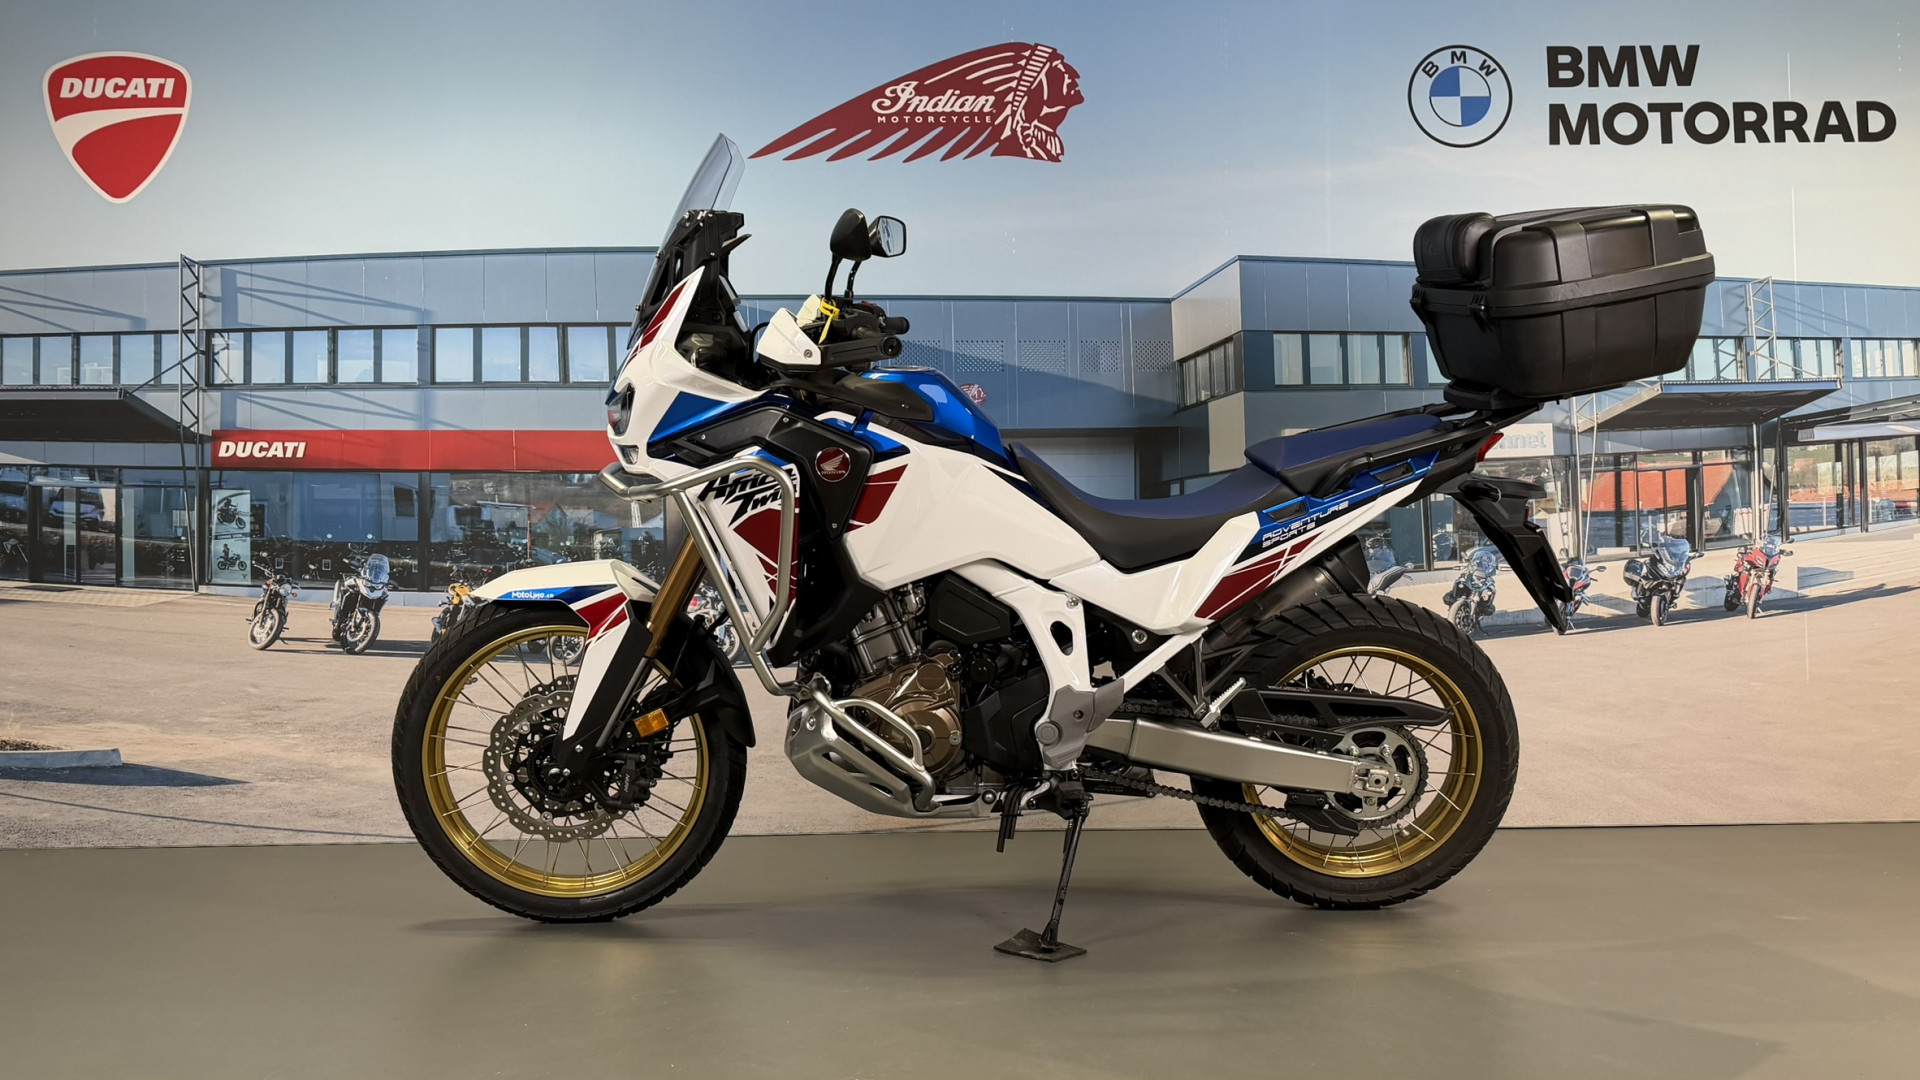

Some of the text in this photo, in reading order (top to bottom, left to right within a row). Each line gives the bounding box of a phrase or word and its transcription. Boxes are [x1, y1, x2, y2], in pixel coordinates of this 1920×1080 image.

[1421, 51, 1498, 79] BMW
[1546, 44, 1700, 88] BMW
[59, 77, 175, 99] DUCATI
[871, 81, 997, 114] Indian
[877, 115, 992, 124] MOTORCYCLE
[1548, 100, 1897, 146] MOTORRAD
[218, 441, 307, 458] DUCATI
[1262, 500, 1349, 542] ADVENTURE
[1262, 521, 1316, 549] SPORTS
